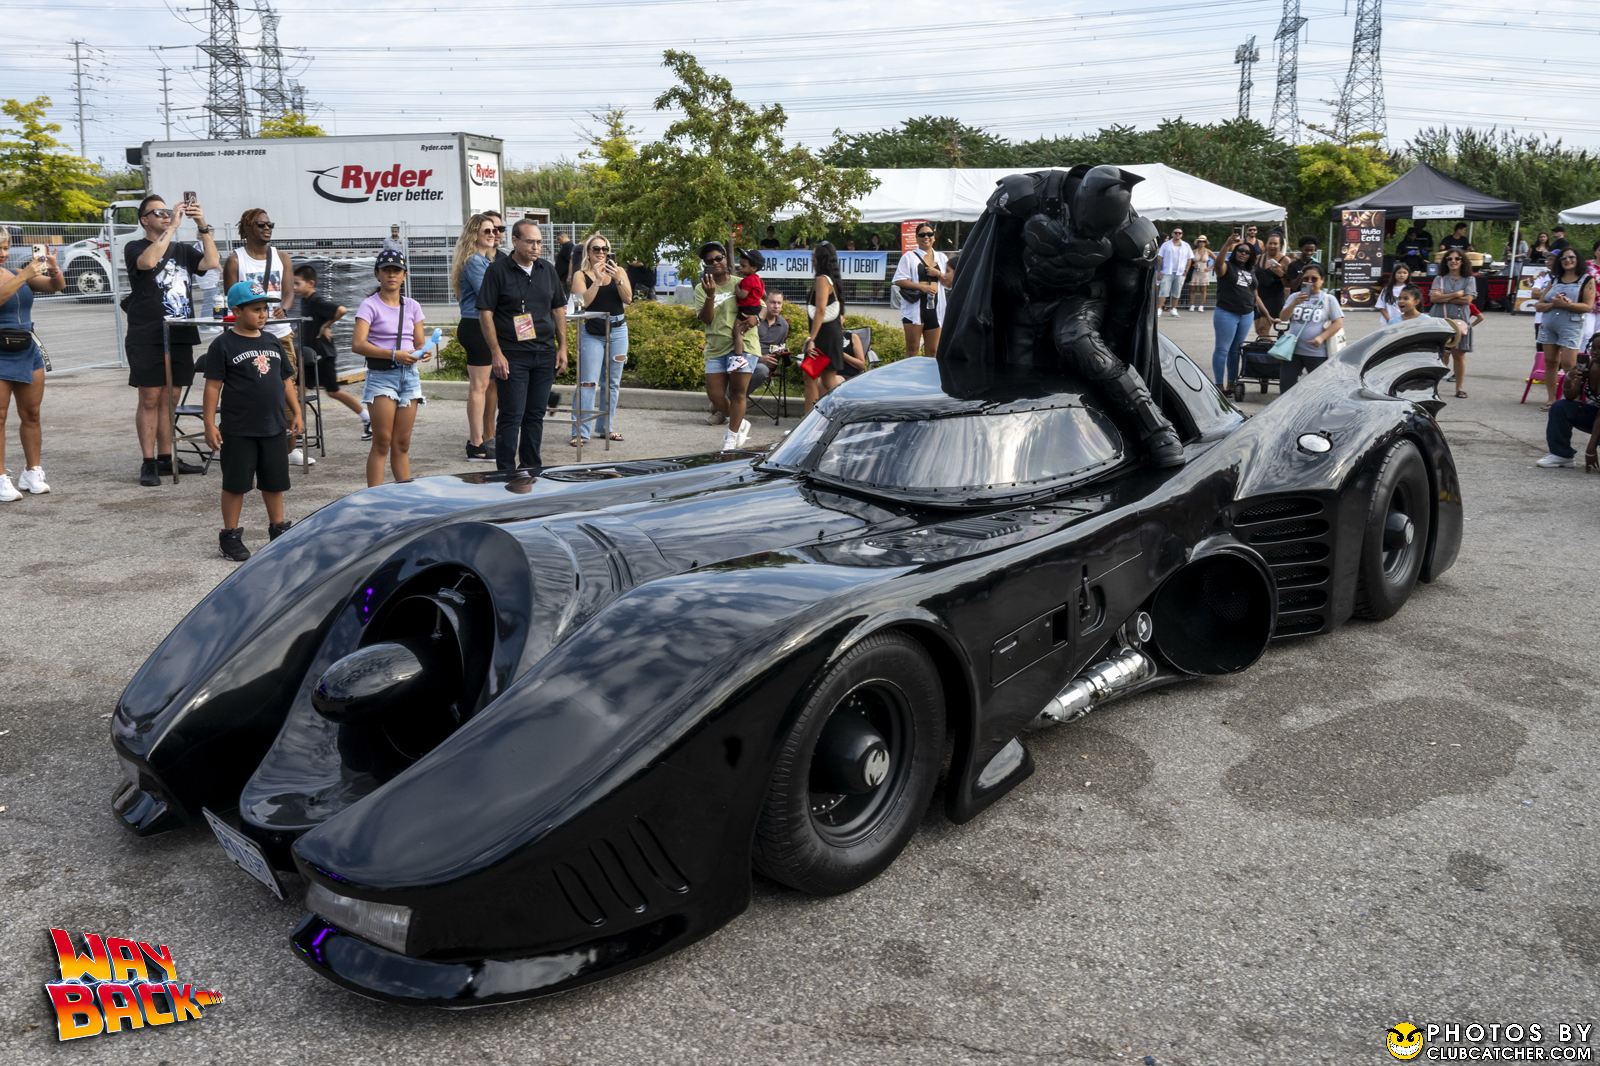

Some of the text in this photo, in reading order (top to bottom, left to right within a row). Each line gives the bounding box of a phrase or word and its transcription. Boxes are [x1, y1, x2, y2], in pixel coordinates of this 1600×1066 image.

[420, 144, 454, 152] Ryder.com
[341, 163, 433, 194] Ryder
[476, 163, 497, 181] Ryder
[375, 188, 444, 201] Ever better.
[1360, 234, 1381, 242] Eats
[786, 257, 809, 272] CASH
[854, 258, 880, 273] DEBIT
[232, 350, 259, 365] CERTIFIED
